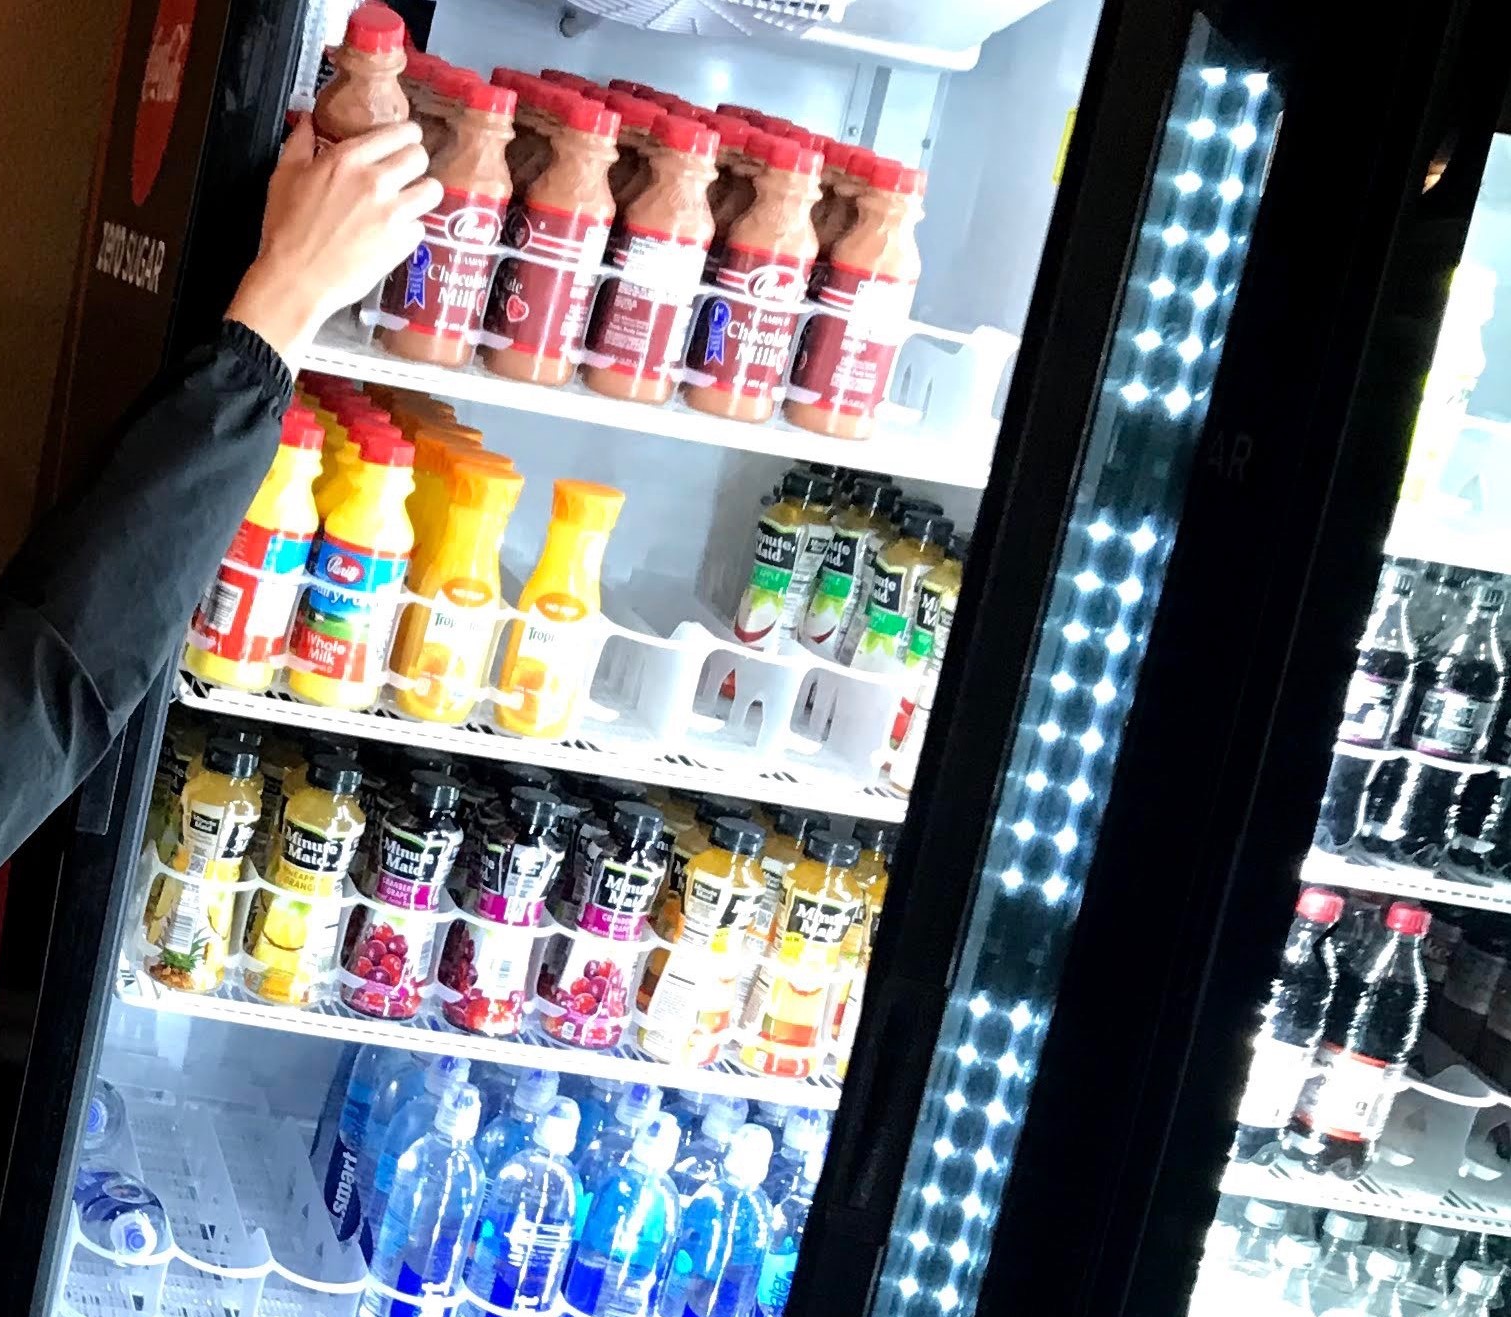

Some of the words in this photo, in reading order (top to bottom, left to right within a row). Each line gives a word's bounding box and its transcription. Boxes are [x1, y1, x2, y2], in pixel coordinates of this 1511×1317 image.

[308, 629, 346, 654] Whole
[308, 649, 335, 667] Milk
[285, 826, 338, 855] Minute
[385, 836, 435, 865] Minute
[288, 843, 332, 869] Maid
[386, 852, 426, 877] Maid
[333, 1151, 357, 1218] smart
